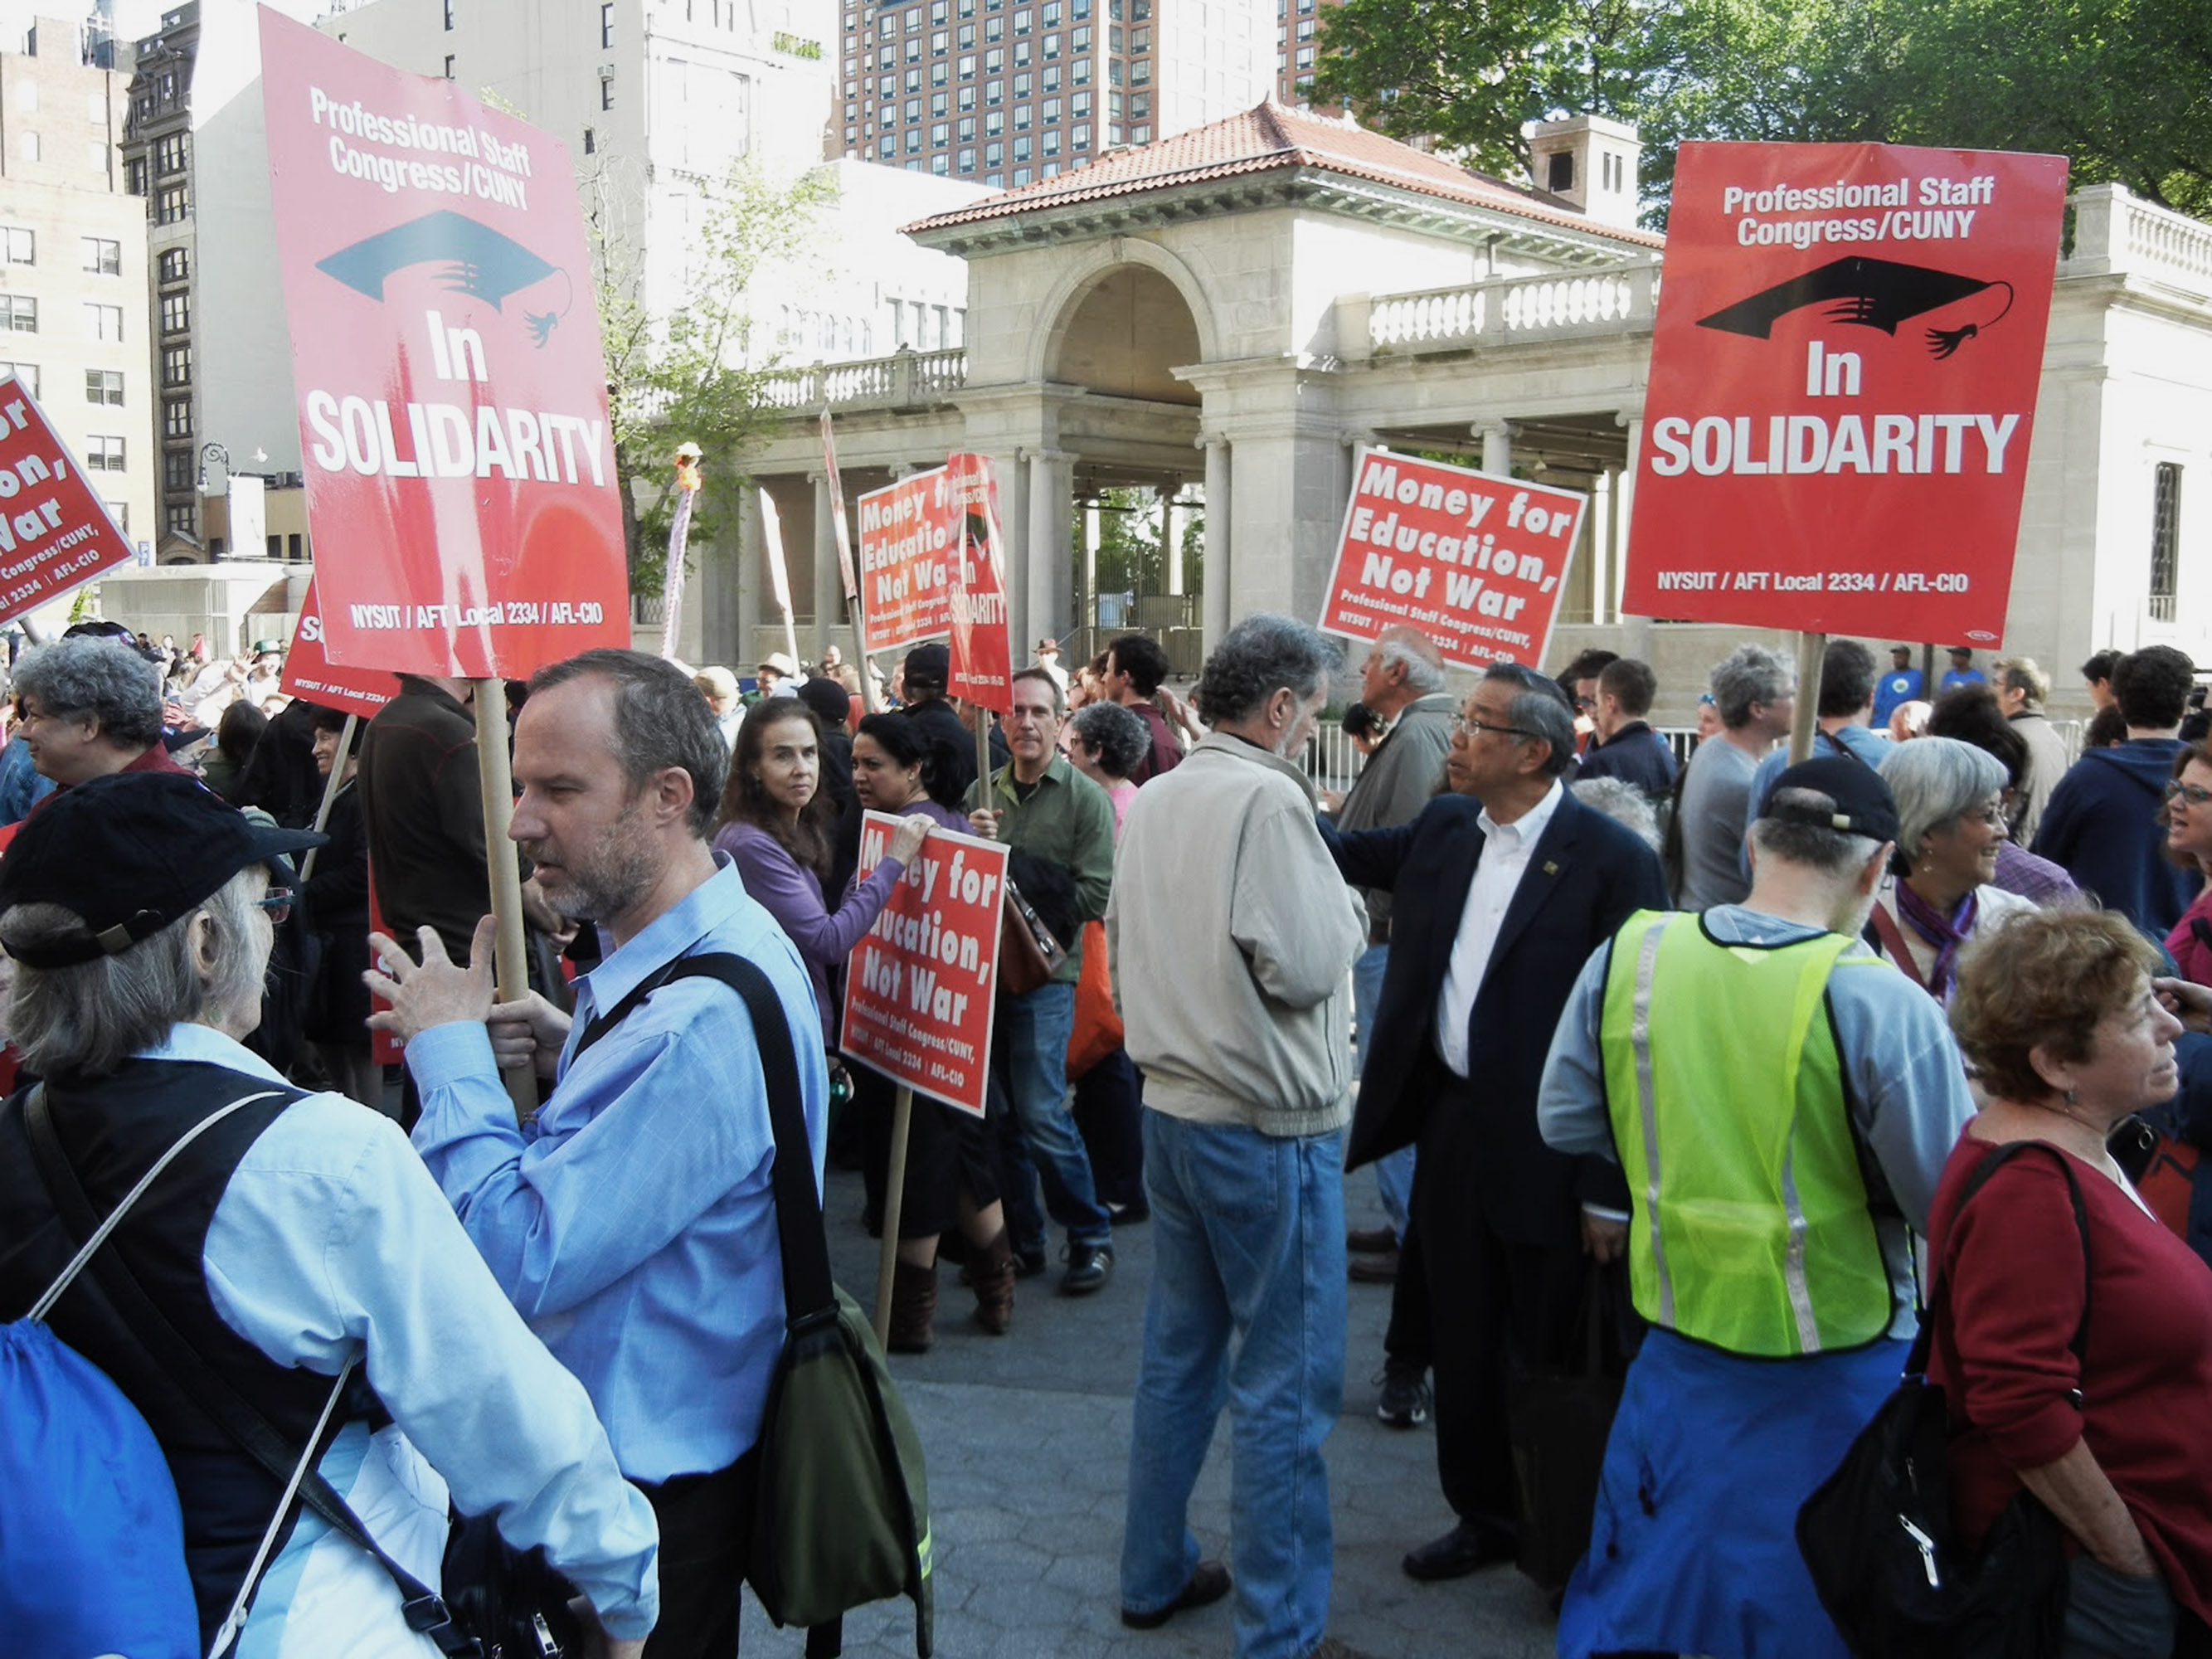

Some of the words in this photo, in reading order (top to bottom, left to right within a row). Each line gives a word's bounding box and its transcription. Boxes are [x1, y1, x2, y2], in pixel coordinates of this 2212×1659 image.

[310, 85, 479, 158] Professional
[481, 130, 532, 178] Staff
[329, 135, 527, 211] Congress/CUNY
[1723, 178, 1908, 214] Professional
[1918, 176, 1994, 206] Staff
[1737, 210, 1976, 250] Congress/CUNY
[425, 309, 489, 382] In
[1806, 340, 1861, 397] In
[306, 389, 605, 487] SOLIDARITY
[1651, 414, 2020, 477] SOLIDARITY
[863, 491, 926, 533] Money
[1360, 461, 1495, 528] Money
[1507, 491, 1572, 538] for
[11, 579, 42, 602] 2334
[54, 549, 100, 580] AFL-CIO
[864, 521, 946, 572] Educatio
[1349, 506, 1557, 593] Education,
[877, 569, 909, 605] Not
[1340, 589, 1407, 616] Professional
[1409, 606, 1438, 624] Staff
[1360, 552, 1431, 599] Not
[1445, 571, 1525, 620] War
[1657, 572, 1716, 590] NYSUT
[1733, 572, 1769, 591] AFT
[1774, 572, 1823, 591] Local
[1827, 573, 1875, 591] 2334
[1893, 573, 1968, 592] AFL-CIO
[350, 603, 401, 629] NYSUT
[416, 605, 448, 629] AFT
[455, 601, 504, 627] Local
[507, 601, 539, 625] 2334
[551, 601, 603, 624] AFL-CIO
[1470, 645, 1514, 664] AFL-CIO
[863, 828, 940, 903] Mey
[950, 849, 997, 907] for
[870, 908, 989, 985] ucation,
[863, 945, 901, 1002] Not
[912, 963, 968, 1026] War
